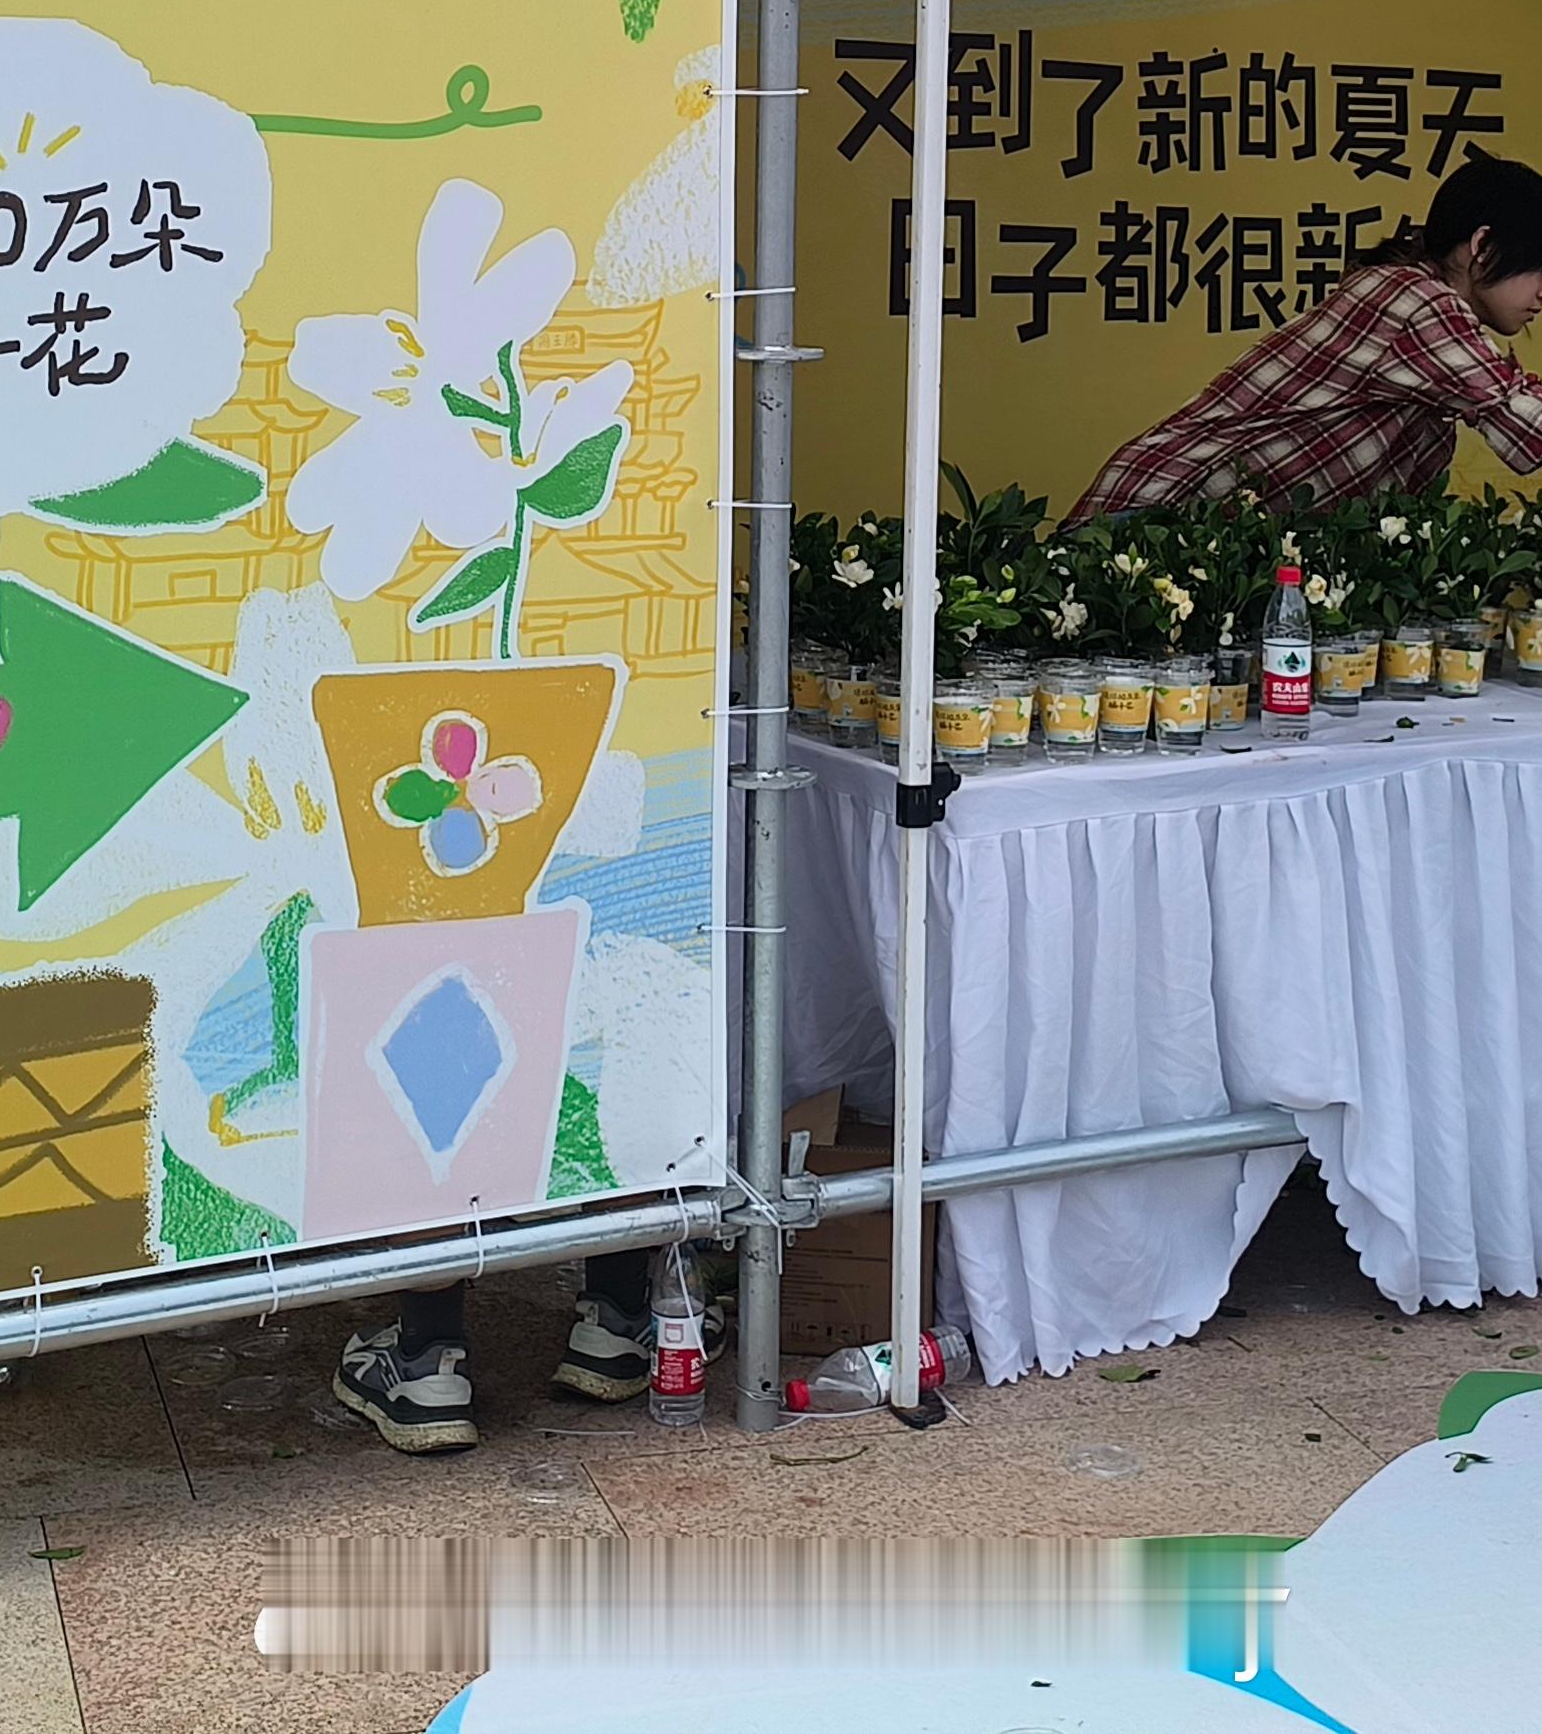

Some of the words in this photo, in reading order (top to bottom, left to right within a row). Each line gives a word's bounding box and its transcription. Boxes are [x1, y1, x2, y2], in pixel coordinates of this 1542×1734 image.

[835, 30, 1505, 180] 又到了新的夏天
[889, 198, 1427, 342] 日子都很新
